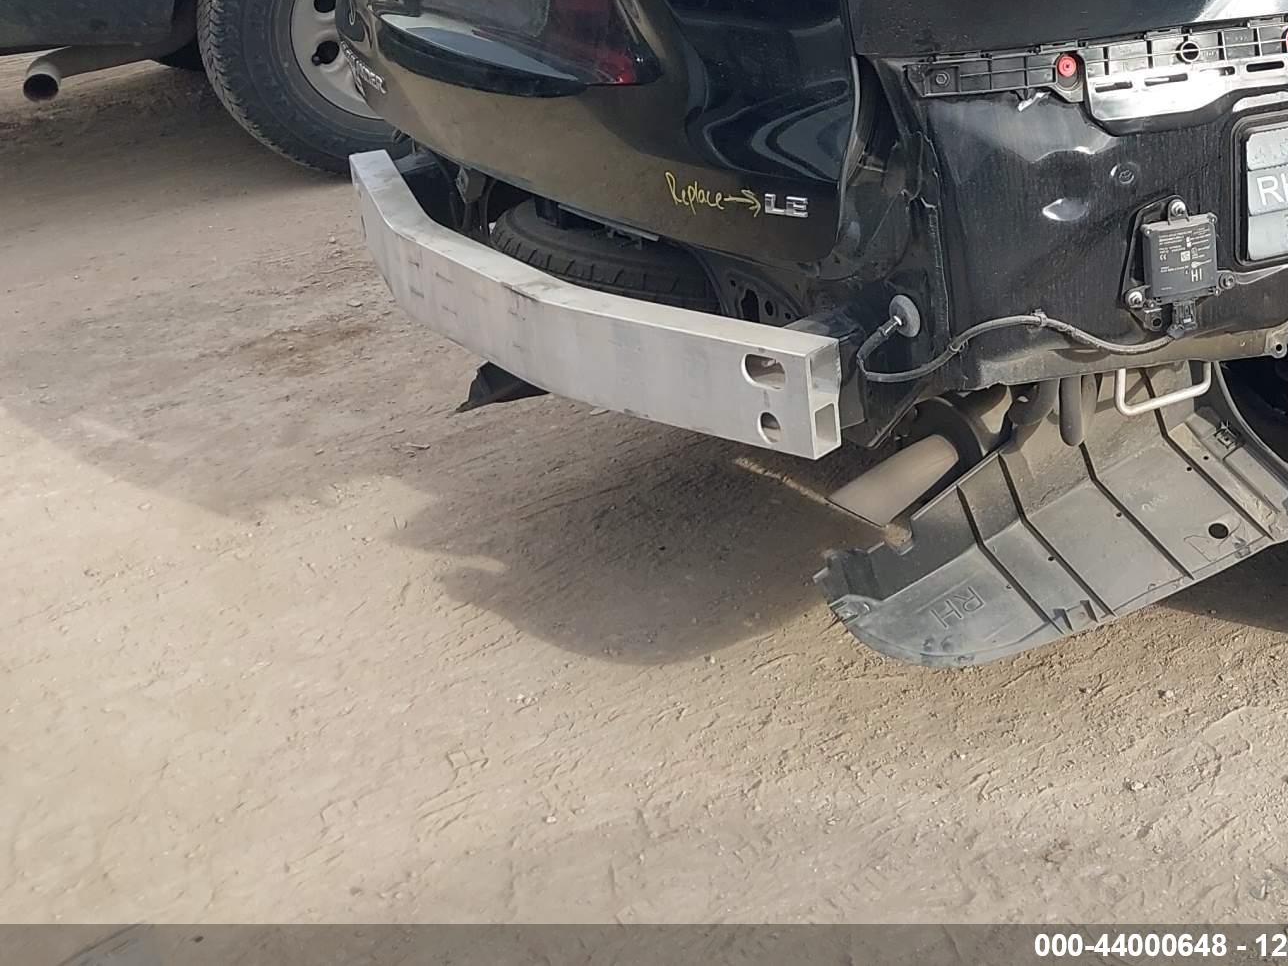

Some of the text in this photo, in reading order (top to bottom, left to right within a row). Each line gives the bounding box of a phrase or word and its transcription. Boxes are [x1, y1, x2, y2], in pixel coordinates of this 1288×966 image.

[664, 171, 725, 216] Replace
[764, 193, 809, 218] LE
[929, 585, 986, 629] RH
